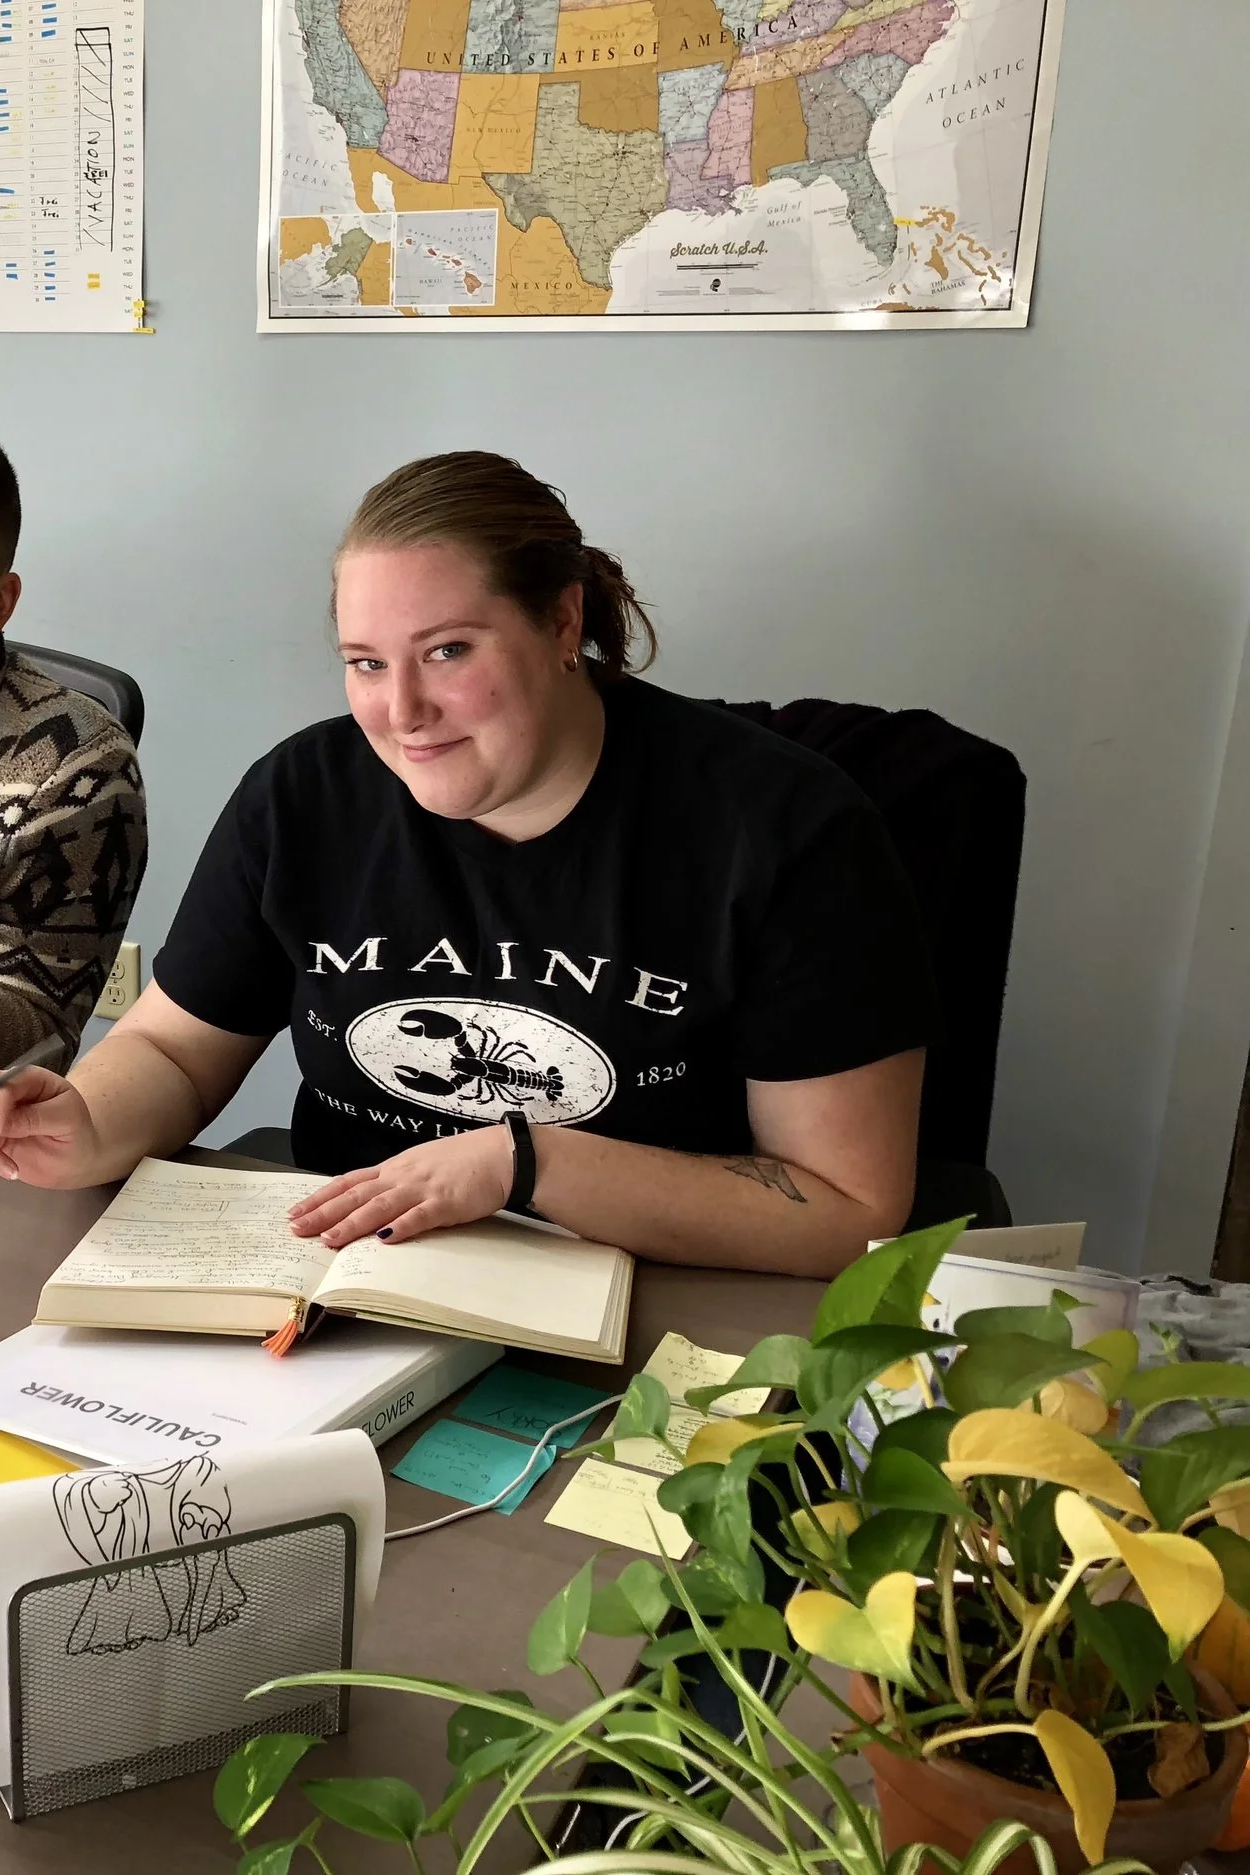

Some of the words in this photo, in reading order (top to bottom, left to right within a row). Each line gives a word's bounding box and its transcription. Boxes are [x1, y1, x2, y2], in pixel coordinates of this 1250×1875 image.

[426, 51, 512, 67] UNITED
[527, 46, 615, 66] STATES
[633, 41, 660, 57] OF
[679, 15, 798, 52] AMERICA
[925, 59, 1025, 104] ATLANTIC
[942, 98, 1006, 129] OCEAN
[86, 131, 105, 228] VACATION
[766, 204, 788, 215] Gulf
[767, 216, 802, 228] Mexico
[670, 242, 720, 259] Scratch
[723, 240, 768, 257] U.S.A.
[510, 281, 573, 291] MEXICO
[306, 937, 688, 1016] MAINE
[307, 1008, 338, 1042] EST.
[636, 1061, 687, 1087] 1820
[315, 1088, 358, 1116] THE
[366, 1108, 424, 1134] WAY
[19, 1381, 223, 1448] CAULIFLOWER
[361, 1390, 415, 1438] FLOWER
